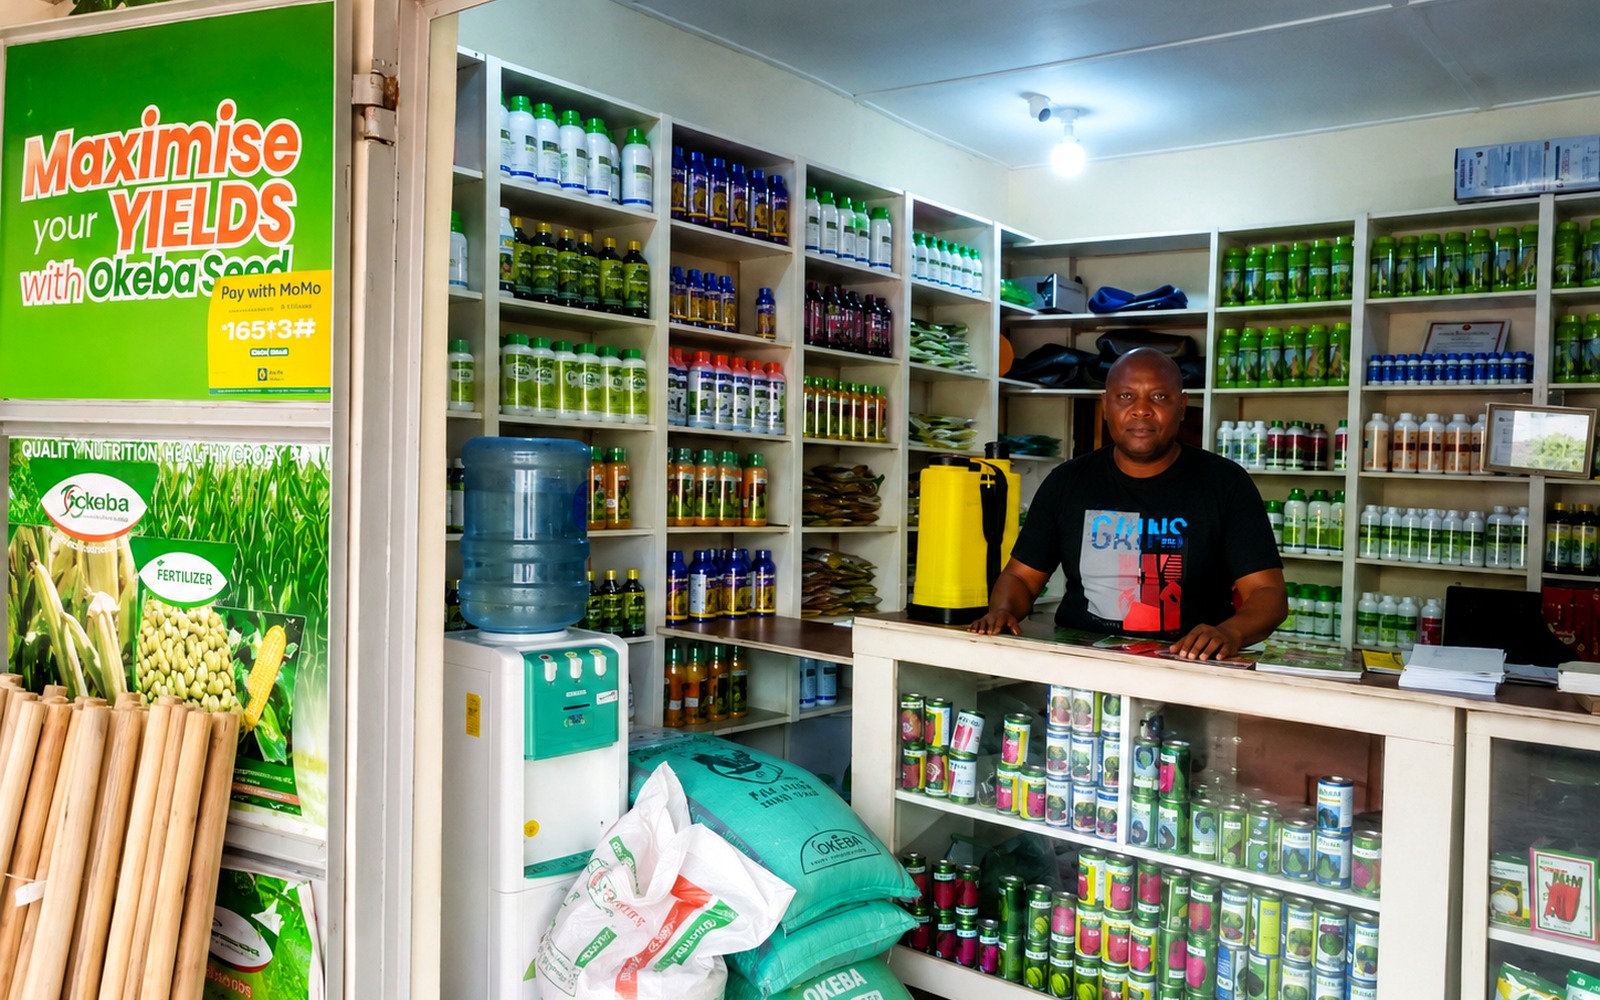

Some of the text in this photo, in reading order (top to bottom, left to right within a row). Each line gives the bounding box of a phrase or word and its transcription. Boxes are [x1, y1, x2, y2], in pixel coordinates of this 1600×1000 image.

[22, 99, 301, 201] Maximise
[33, 179, 297, 255] your YIELDS
[20, 260, 83, 306] with
[87, 254, 199, 301] Okeba
[221, 281, 322, 302] Pay with MoMo
[22, 440, 80, 459] QUALITY
[157, 568, 213, 586] FERTILIZER
[817, 833, 863, 857] OKEBA
[803, 968, 868, 1000] OKEBA
